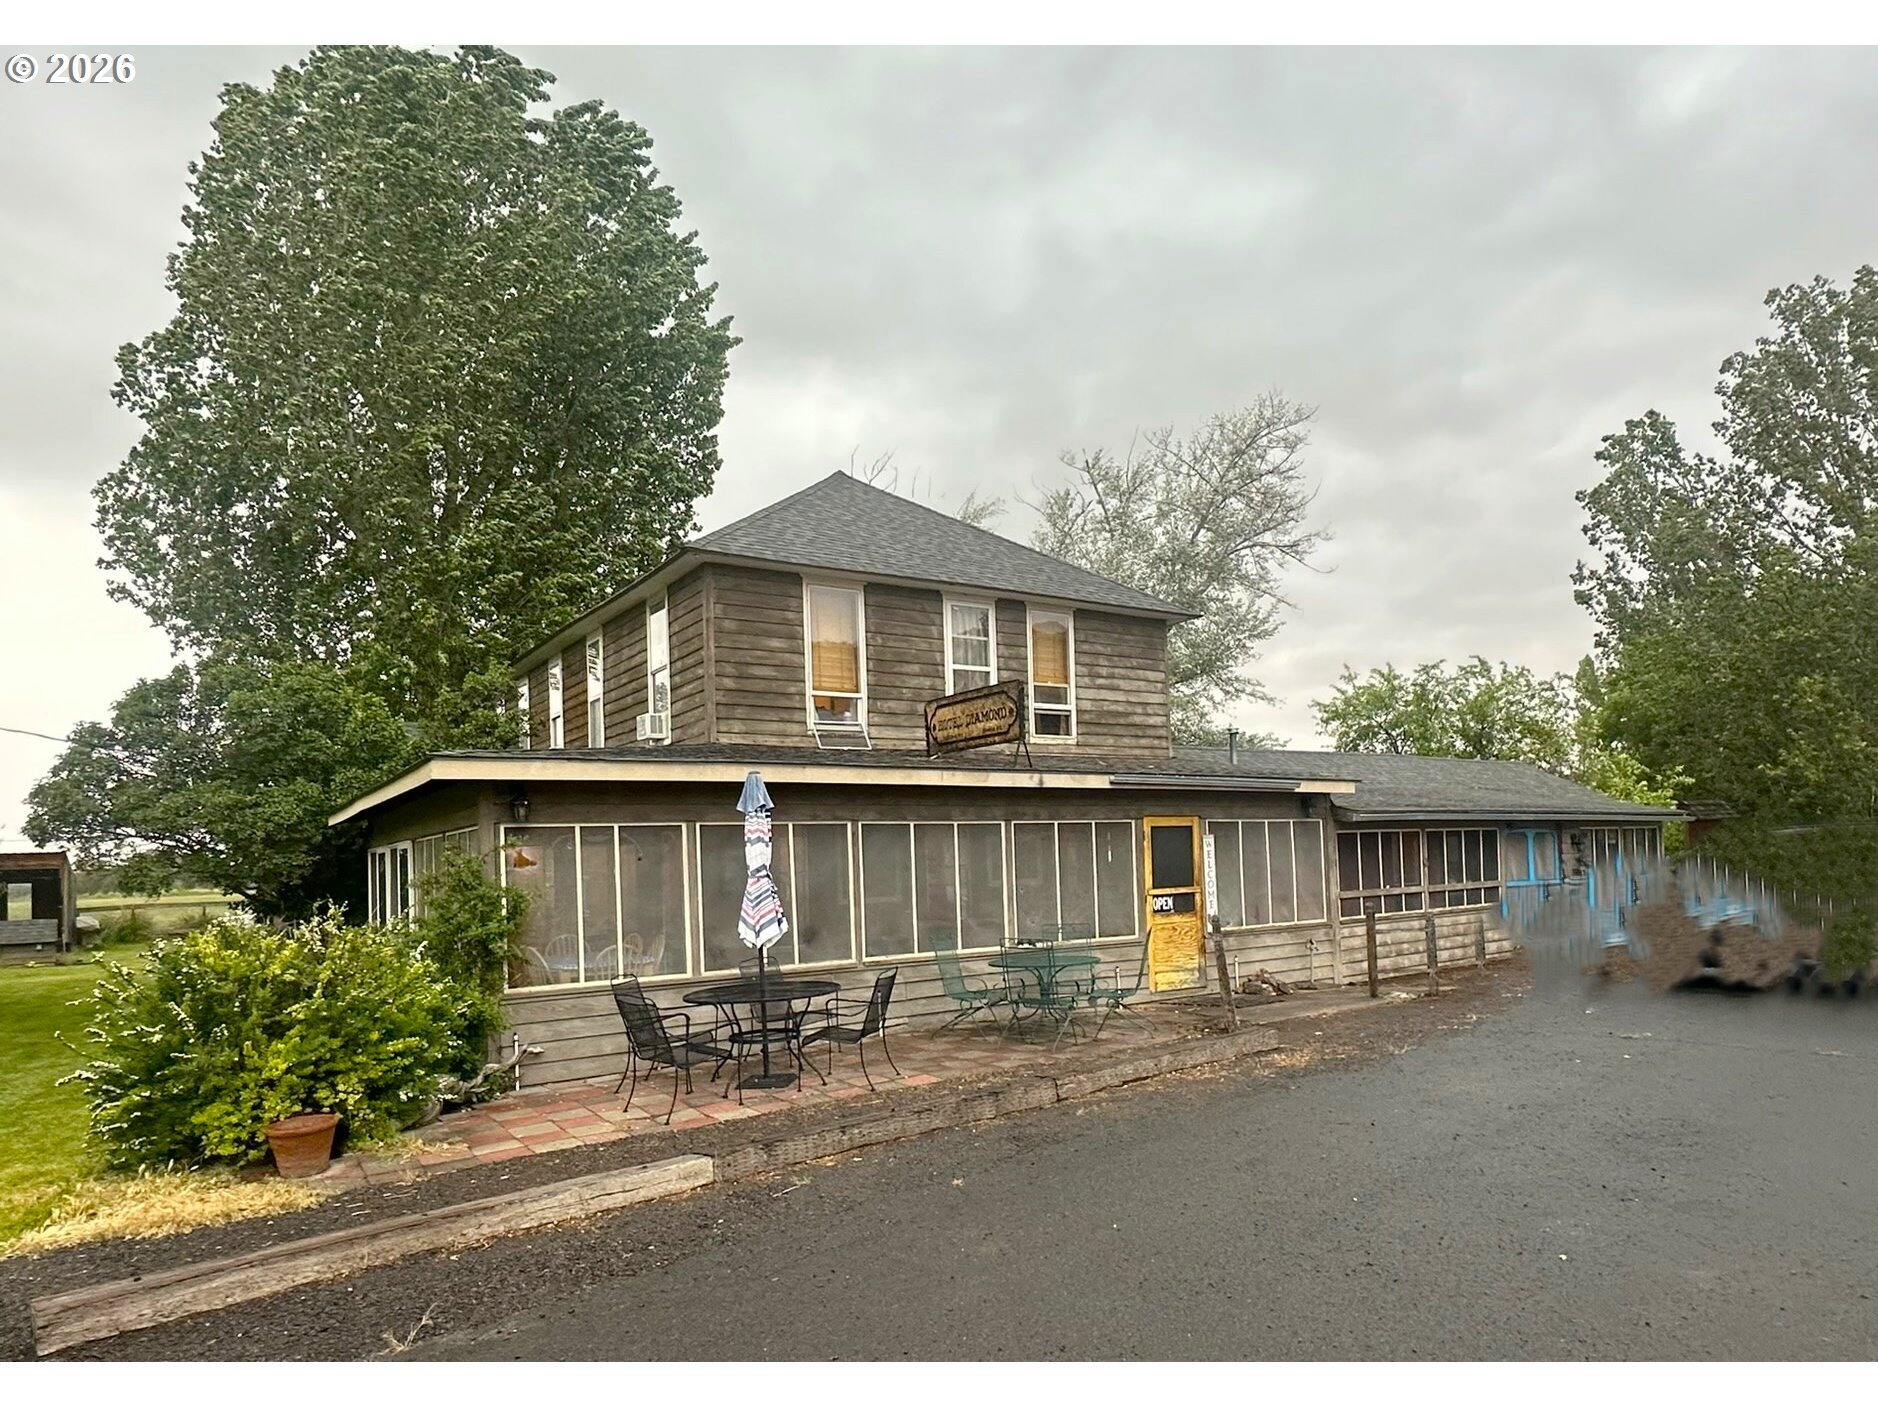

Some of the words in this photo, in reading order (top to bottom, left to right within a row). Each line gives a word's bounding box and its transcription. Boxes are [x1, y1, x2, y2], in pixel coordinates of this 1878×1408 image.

[965, 706, 1007, 727] DIAMOND
[1205, 840, 1215, 910] WELCOME
[1153, 896, 1174, 912] OPEN
